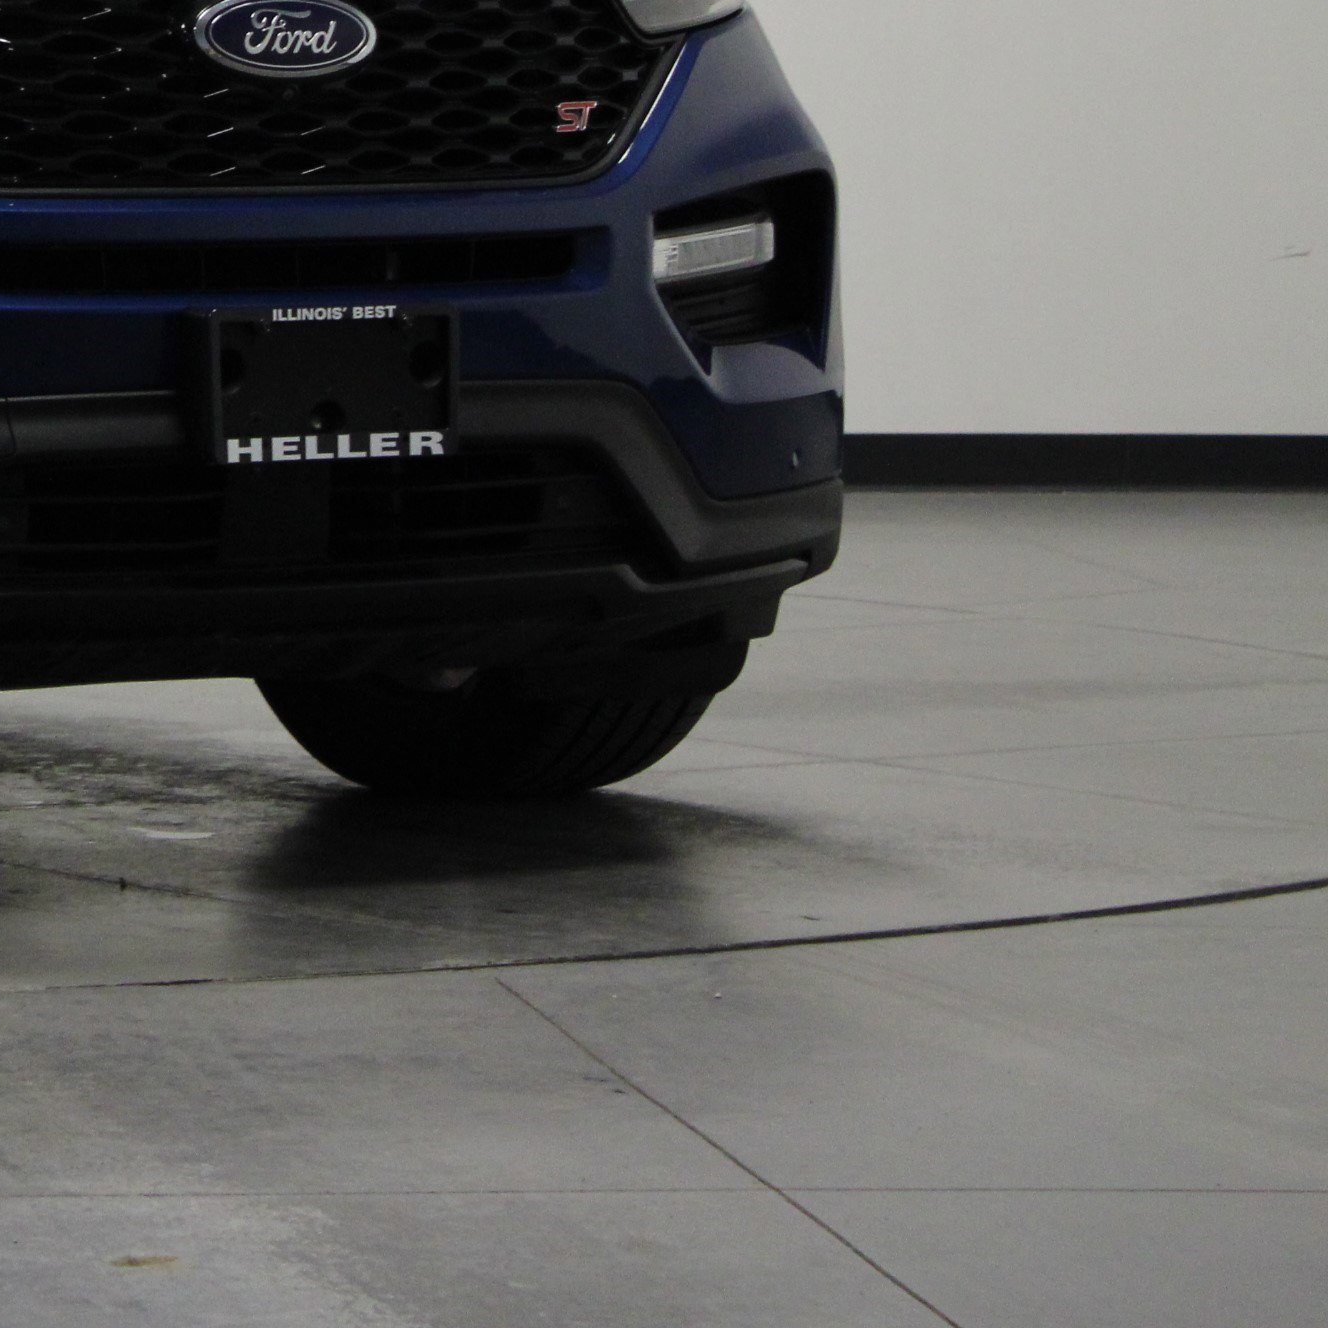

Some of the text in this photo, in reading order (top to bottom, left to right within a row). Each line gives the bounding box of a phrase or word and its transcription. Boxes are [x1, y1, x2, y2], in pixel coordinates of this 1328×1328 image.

[244, 8, 338, 55] Ford
[555, 100, 598, 133] ST
[352, 305, 396, 319] BEST
[226, 430, 444, 464] HELLER
